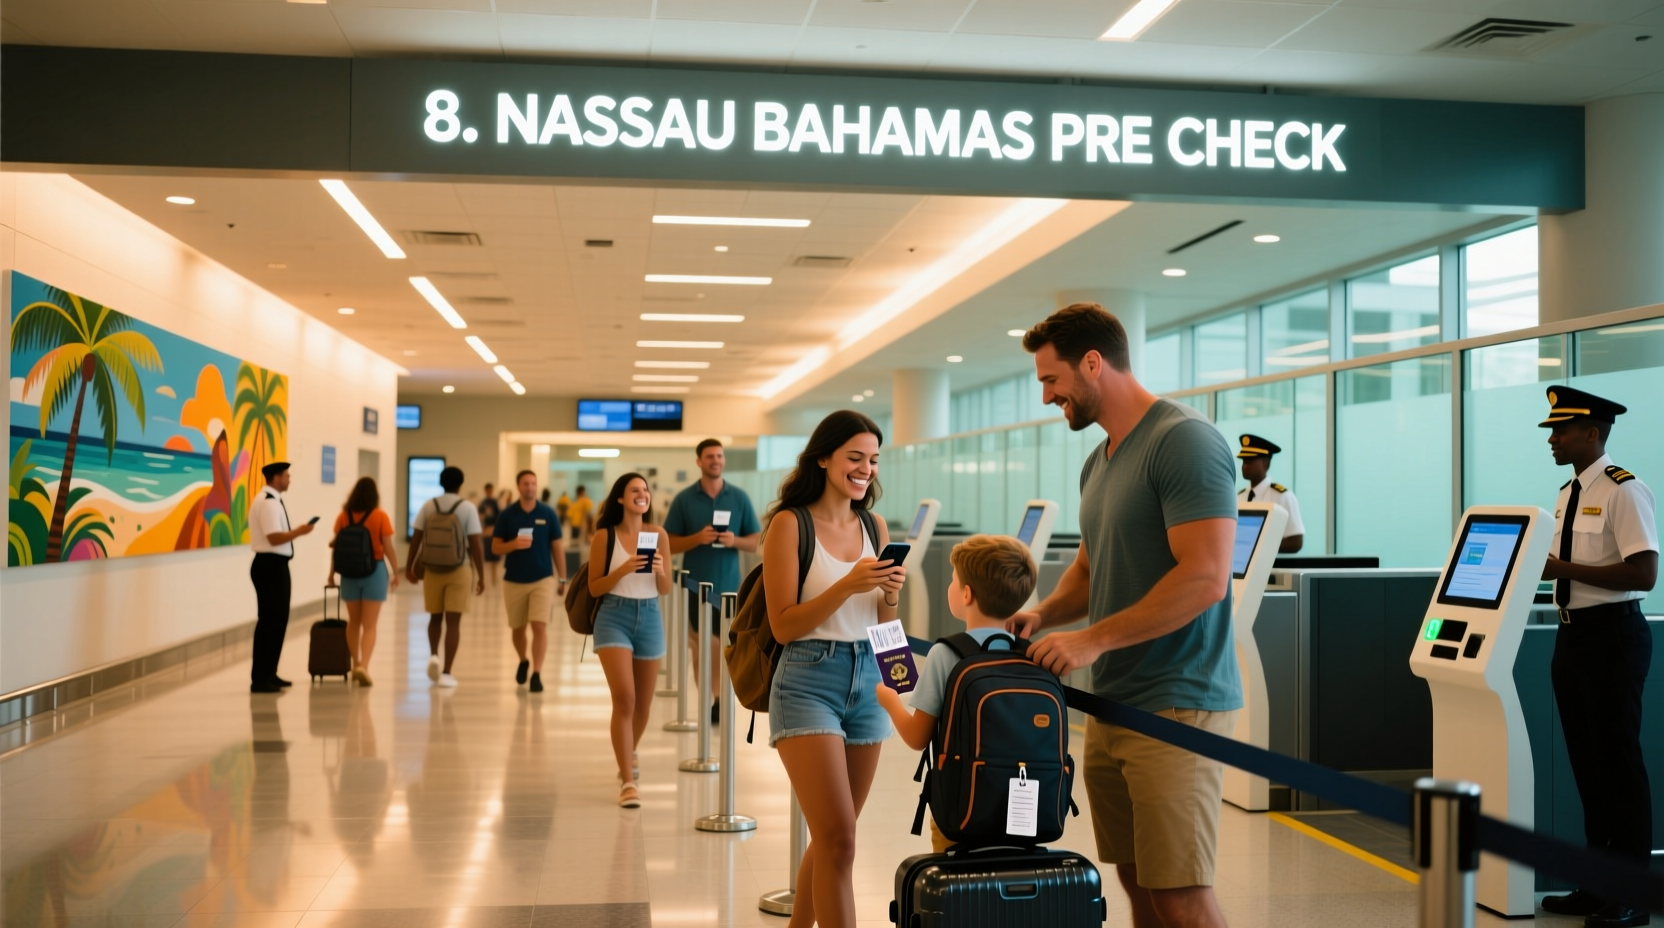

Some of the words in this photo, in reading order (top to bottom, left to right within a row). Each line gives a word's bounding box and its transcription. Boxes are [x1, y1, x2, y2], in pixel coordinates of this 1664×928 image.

[423, 89, 479, 144] 8.
[496, 92, 735, 151] NASSAU
[753, 101, 1035, 162] BAHAMAS
[1051, 112, 1153, 165] PRE
[1167, 116, 1347, 172] CHECK
